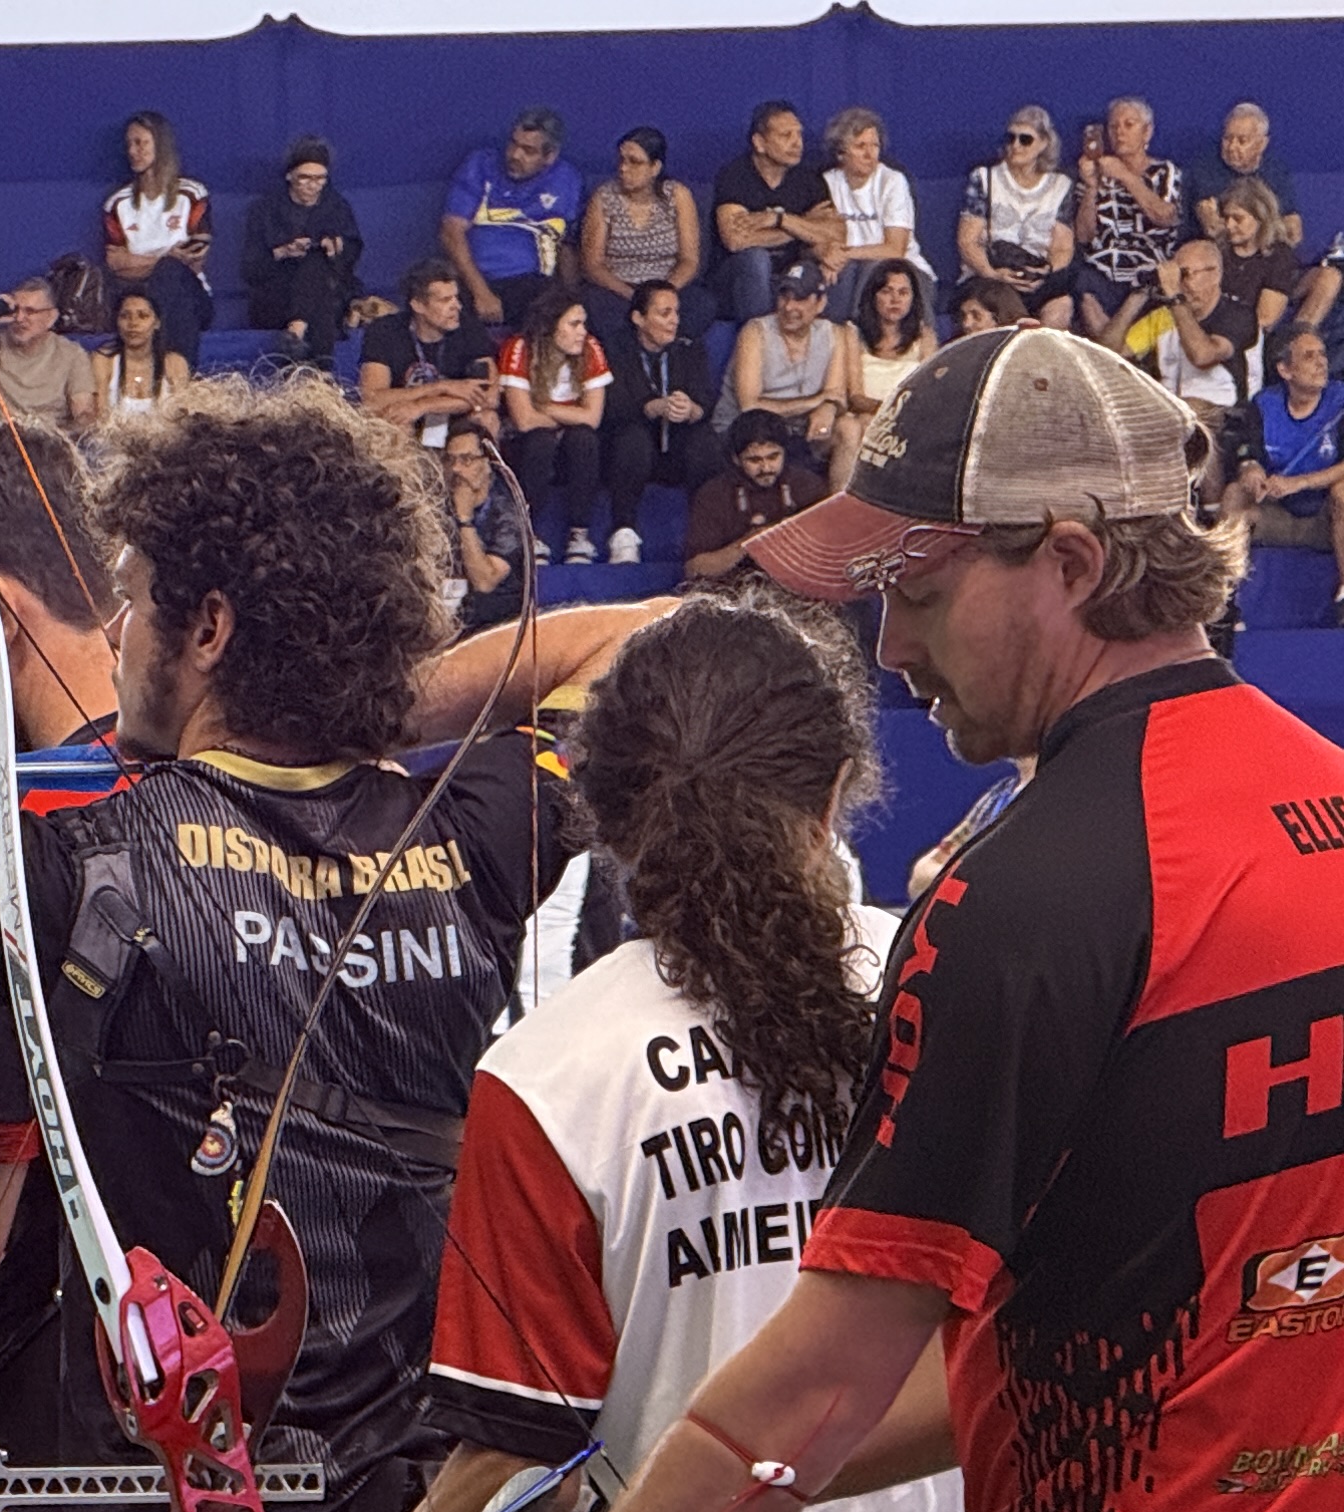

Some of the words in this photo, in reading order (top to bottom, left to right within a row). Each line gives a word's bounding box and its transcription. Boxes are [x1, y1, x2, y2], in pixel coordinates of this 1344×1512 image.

[178, 823, 343, 900] DISPARA
[234, 911, 462, 988] PASSINI
[641, 1112, 745, 1200] TIRO
[1226, 1307, 1344, 1343] EASTO
